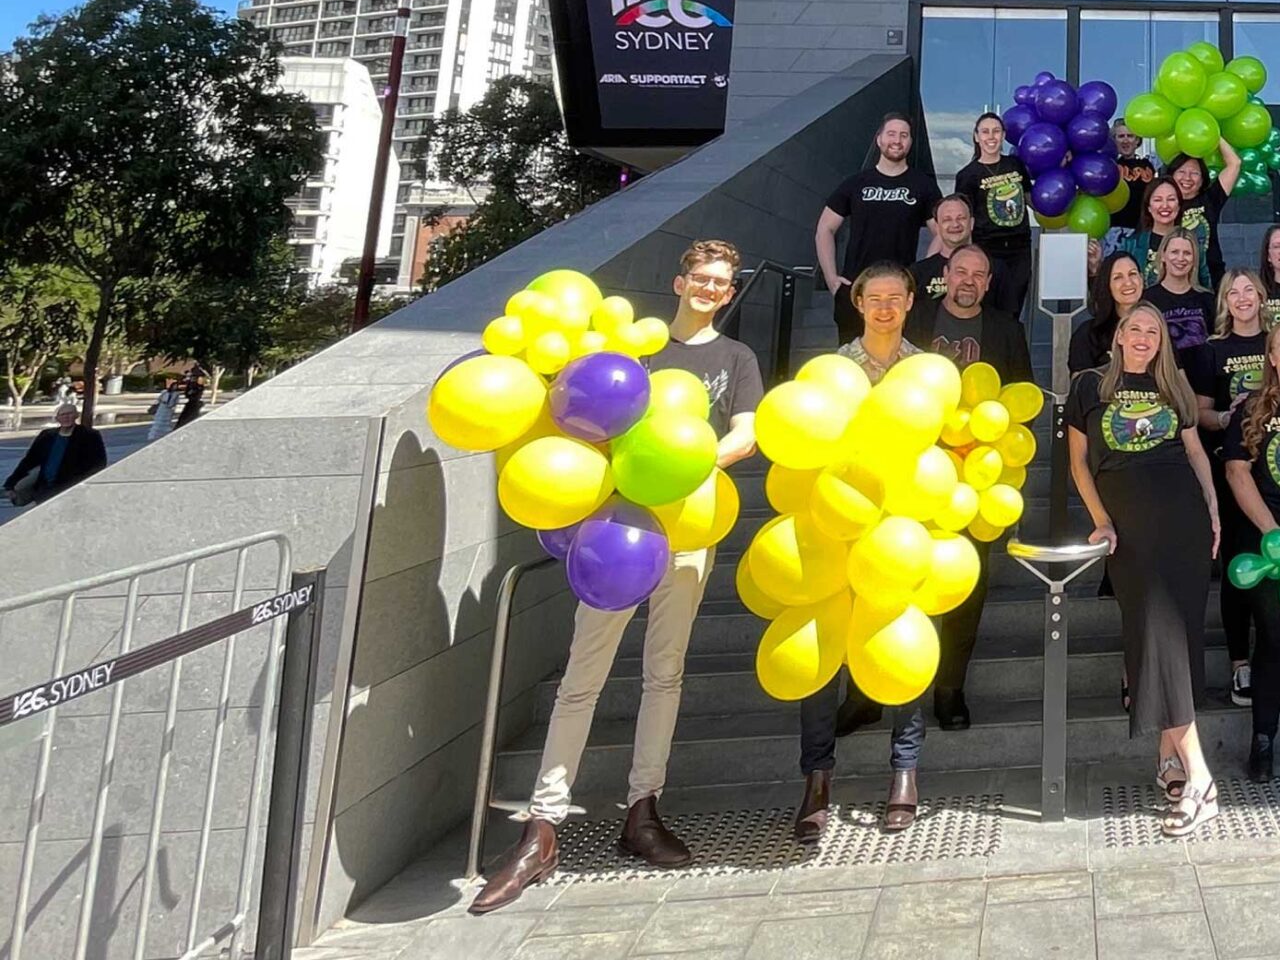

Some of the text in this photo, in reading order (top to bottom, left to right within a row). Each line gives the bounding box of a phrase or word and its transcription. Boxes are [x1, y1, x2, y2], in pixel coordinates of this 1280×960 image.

[614, 30, 714, 50] SYDNEY
[629, 74, 707, 85] SUPPORTACT
[1227, 355, 1265, 365] AUSMU
[273, 584, 314, 617] SYDNEY
[50, 661, 117, 705] SYDNEY
